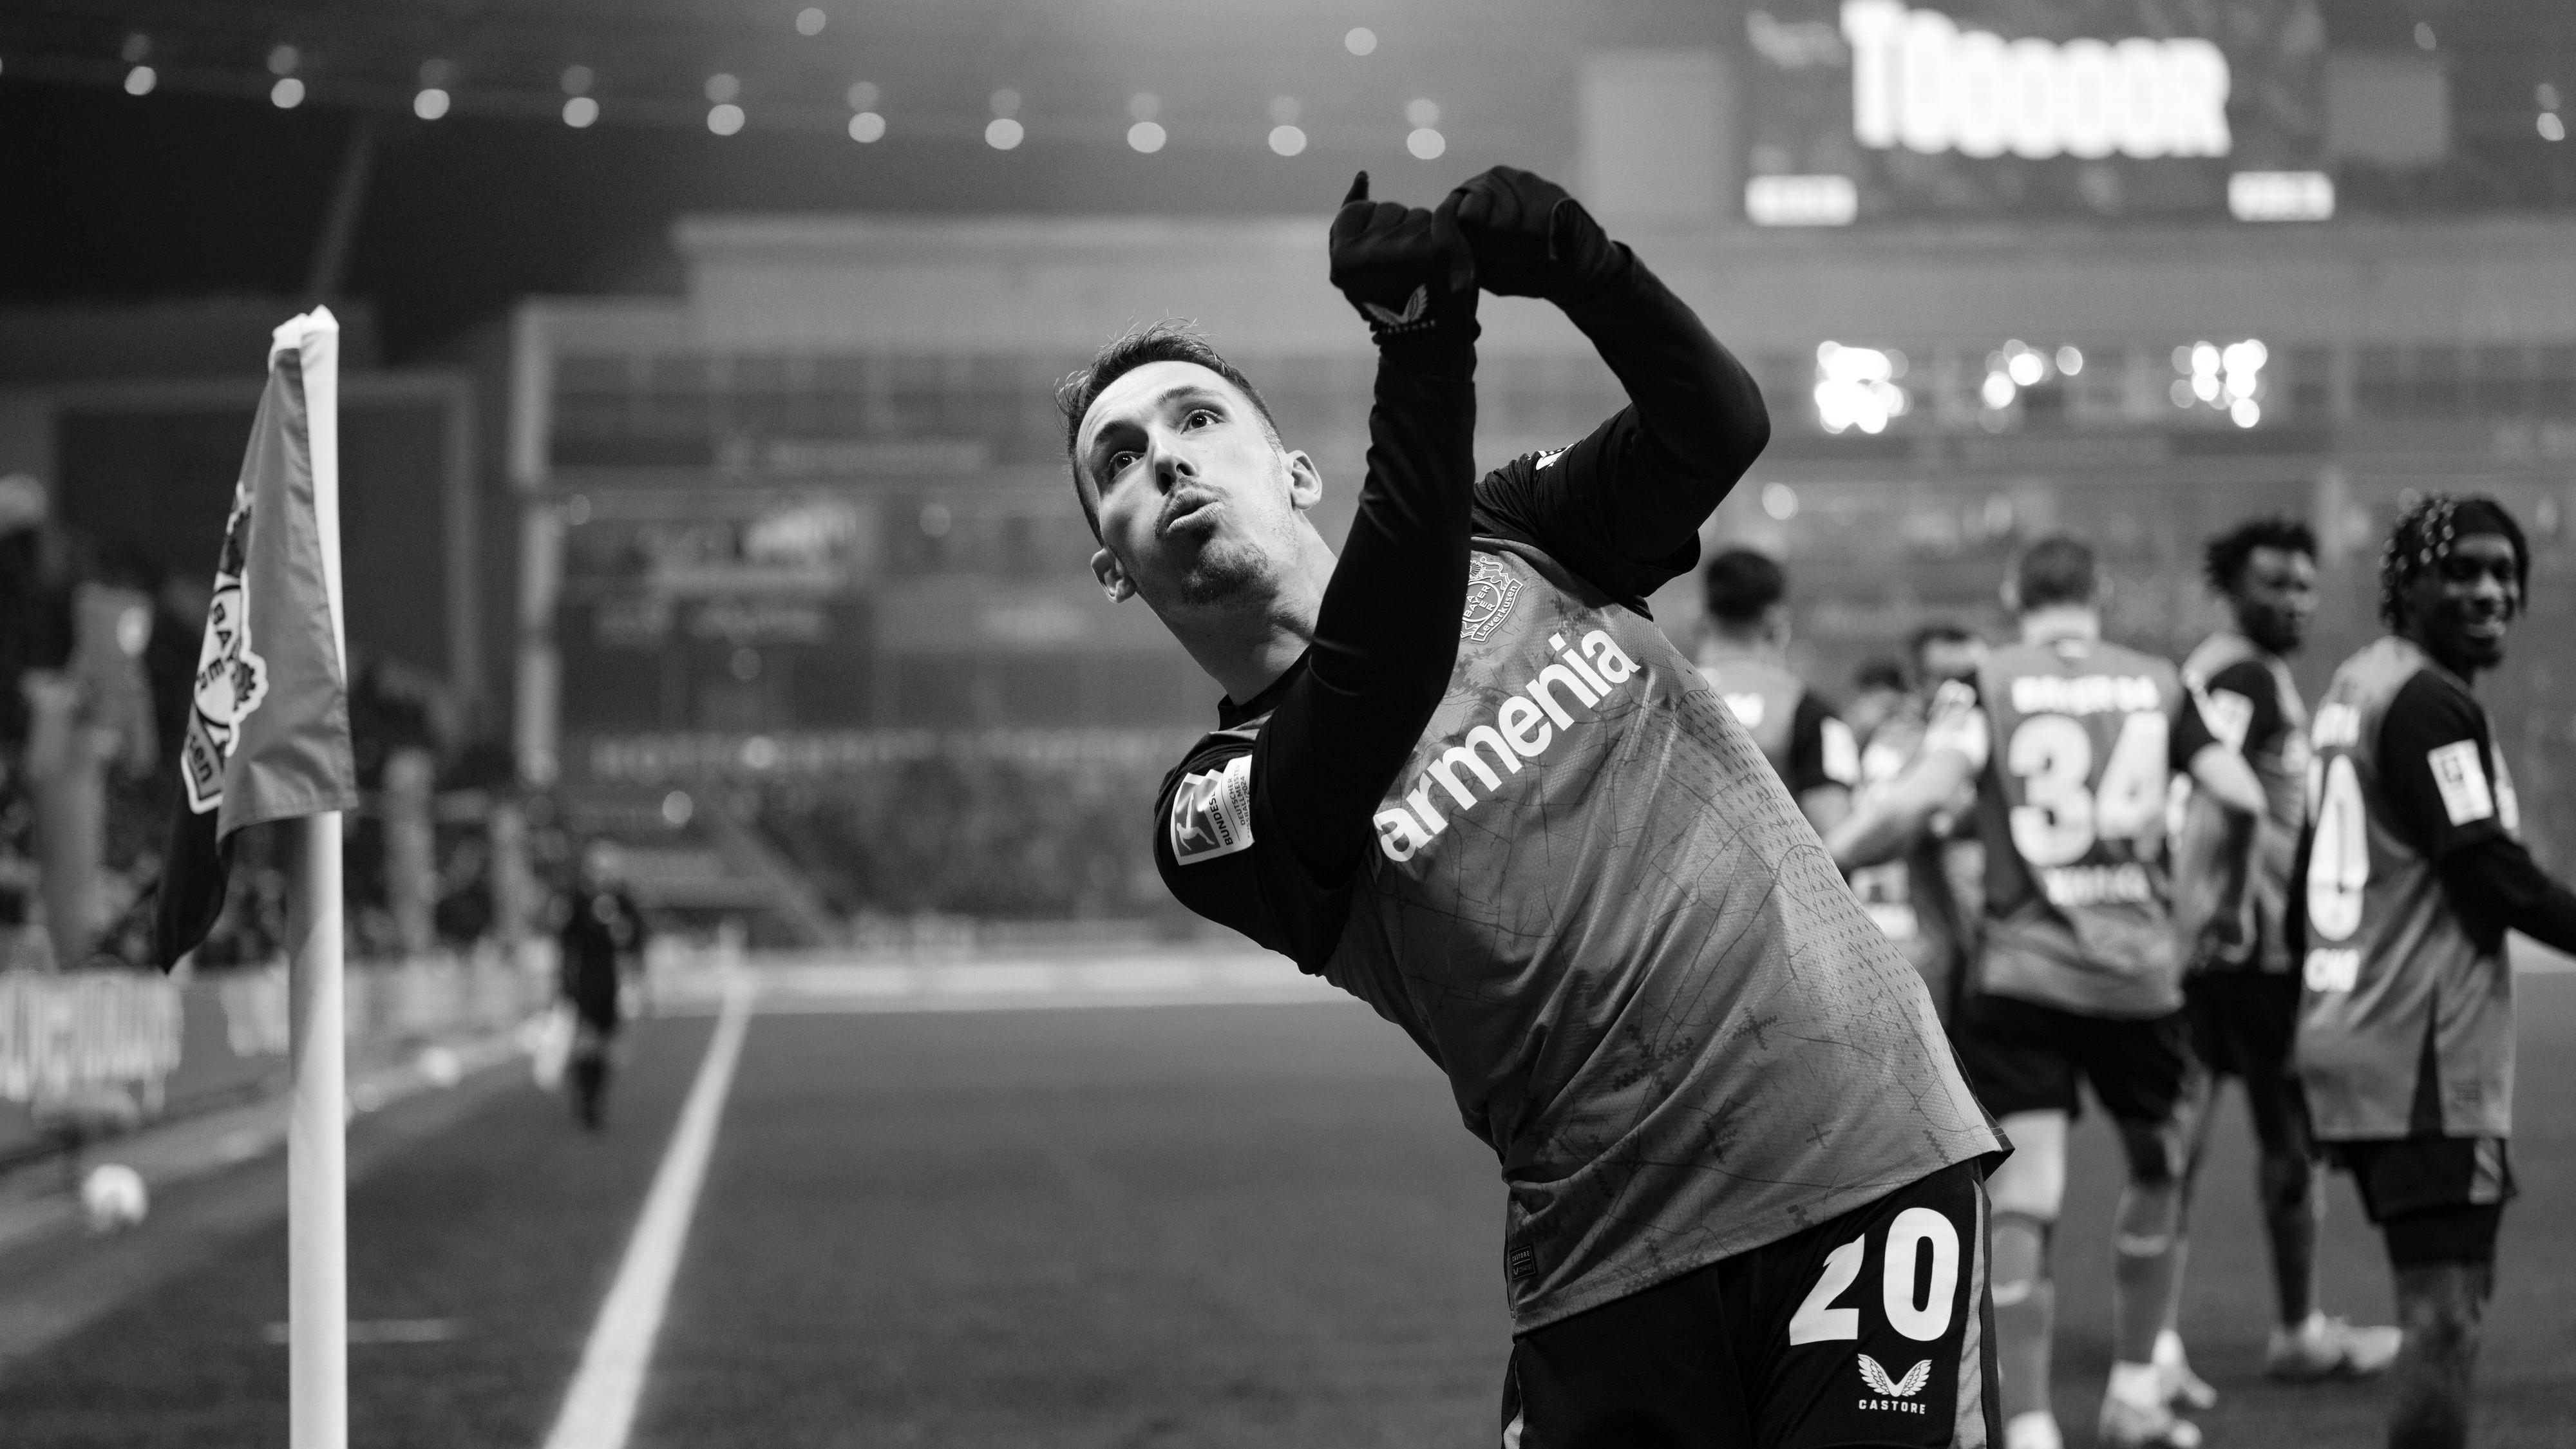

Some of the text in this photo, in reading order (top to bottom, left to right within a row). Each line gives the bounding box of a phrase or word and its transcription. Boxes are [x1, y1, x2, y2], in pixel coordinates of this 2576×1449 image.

[1477, 585, 1518, 637] Leverkusen
[1373, 629, 1642, 862] armenia
[2007, 710, 2170, 867] 34
[1227, 778, 1245, 826] DEUTSCHER
[1789, 1207, 1960, 1347] 20
[1859, 1399, 1926, 1415] CASTORE
